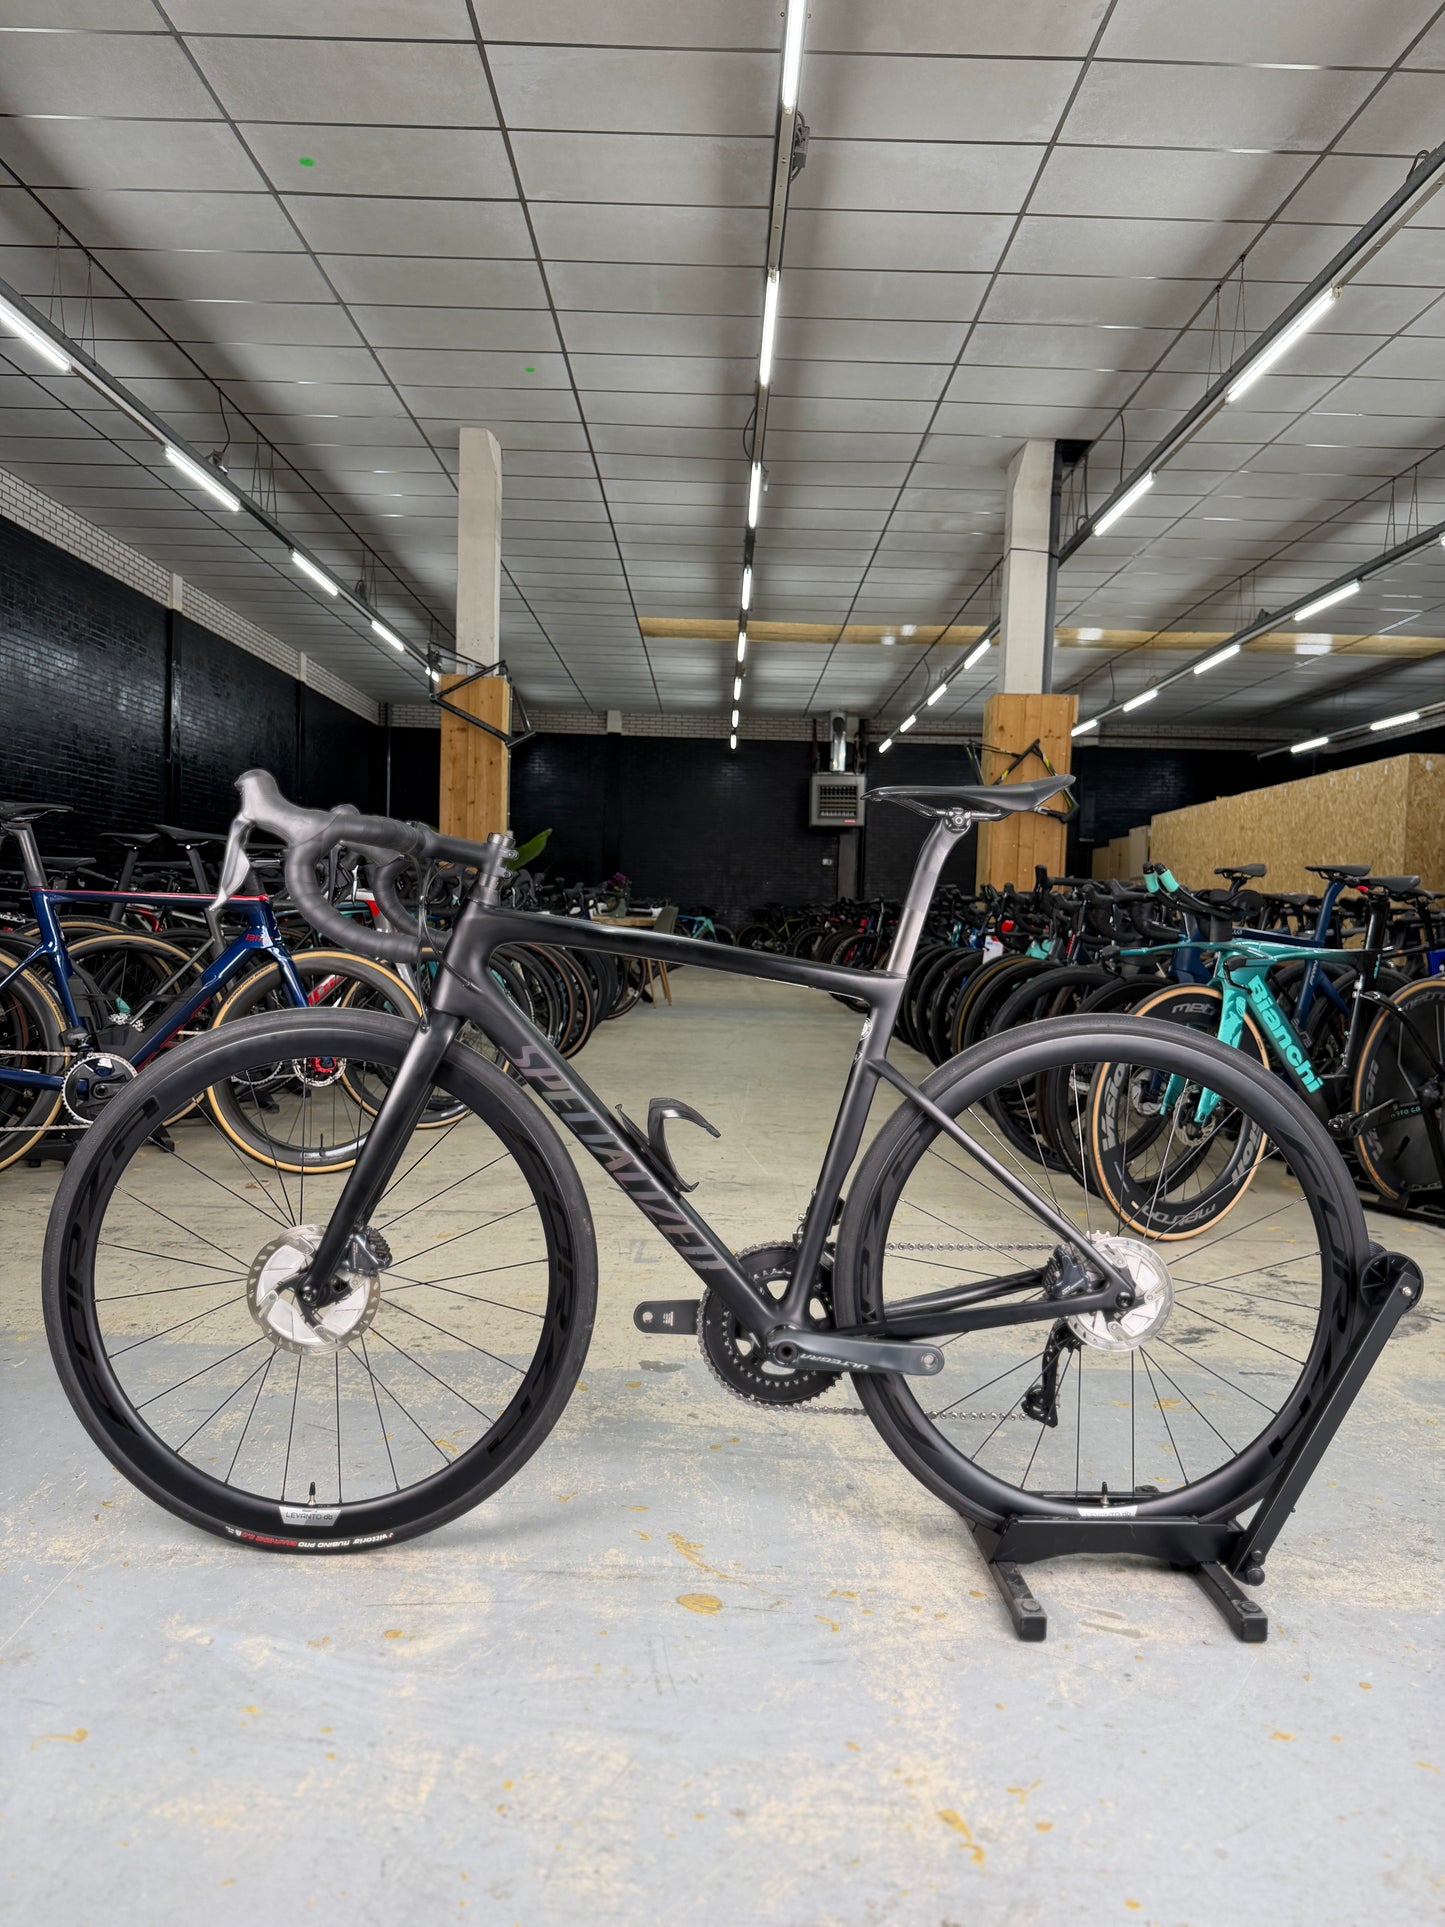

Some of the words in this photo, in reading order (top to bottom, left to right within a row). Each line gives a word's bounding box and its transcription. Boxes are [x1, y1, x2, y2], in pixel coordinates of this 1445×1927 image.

[1247, 974, 1325, 1096] Bianchi
[511, 1044, 729, 1271] SPECIALIZED
[800, 1353, 869, 1370] ULTEGRA
[285, 1511, 322, 1520] LEVANTO
[297, 1541, 316, 1549] PRO
[317, 1539, 351, 1549] RUBINO
[352, 1532, 389, 1545] vittoria
